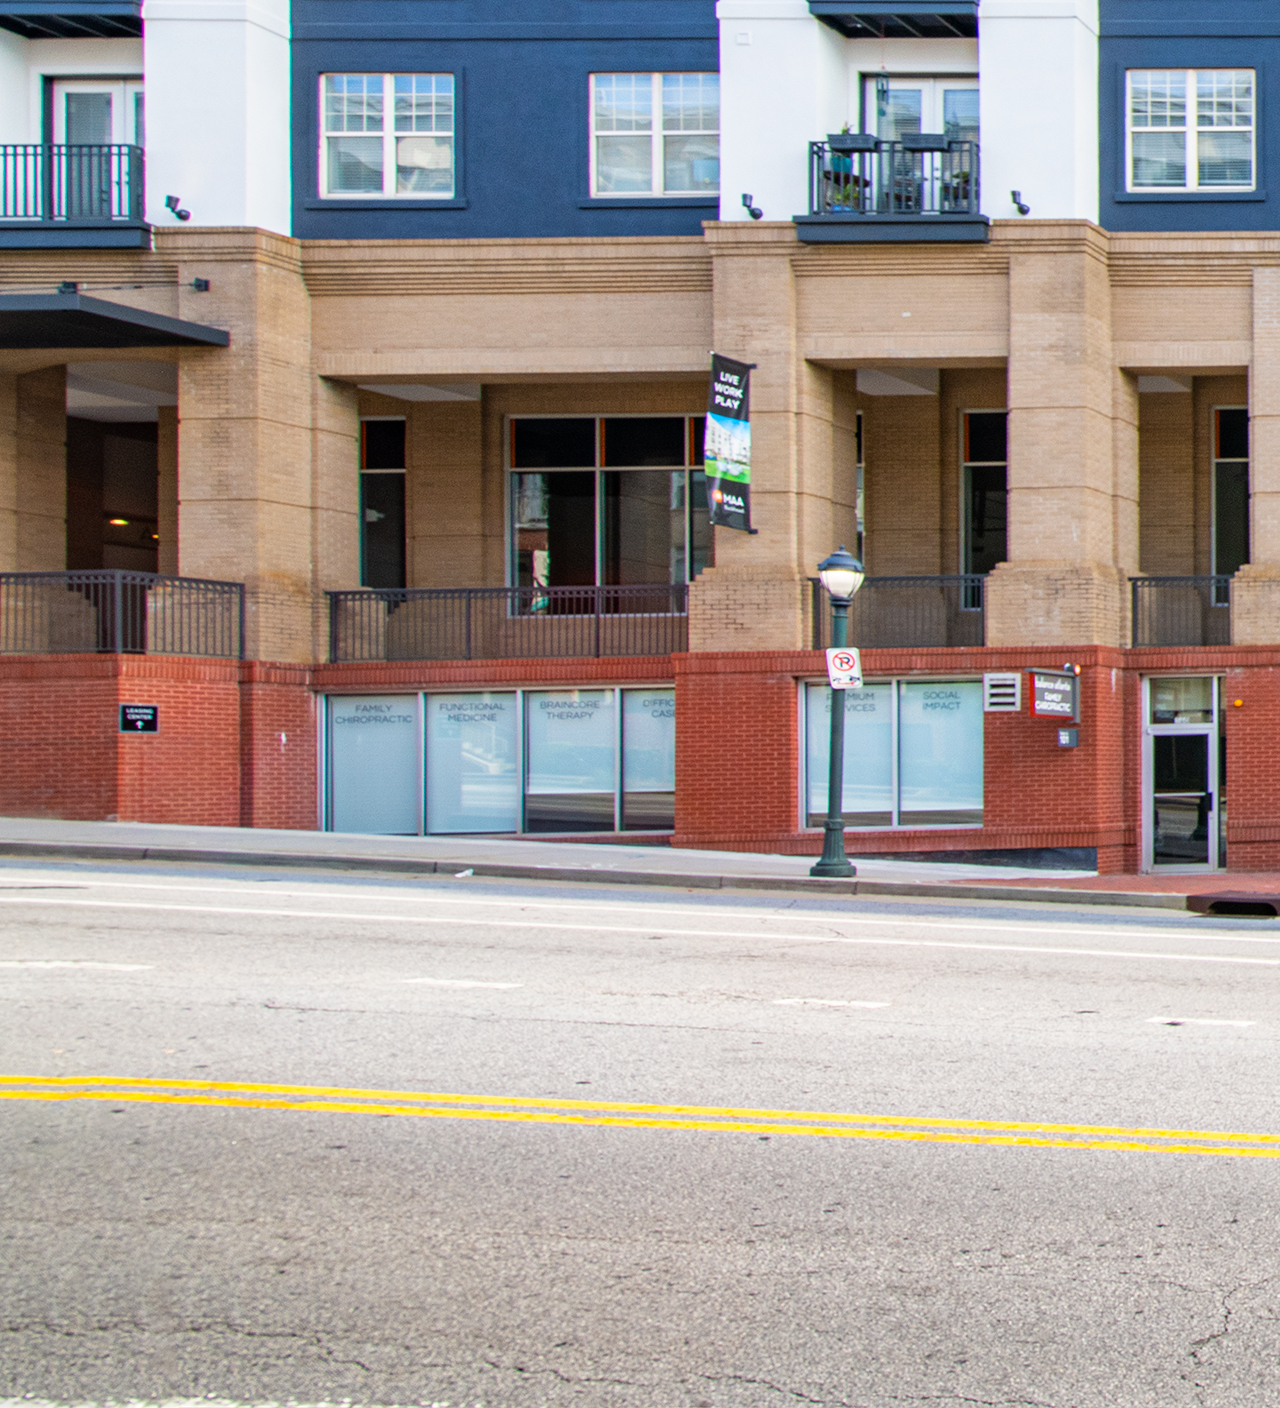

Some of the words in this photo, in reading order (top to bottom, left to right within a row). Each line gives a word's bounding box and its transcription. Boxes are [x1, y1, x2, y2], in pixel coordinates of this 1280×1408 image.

[719, 371, 740, 386] LIVE
[713, 382, 743, 399] WORK
[714, 395, 740, 409] PLAY
[723, 493, 745, 507] MAA
[826, 692, 875, 701] PMIUM
[922, 691, 961, 700] SOCIAL
[355, 704, 393, 713] FAMILY
[439, 702, 505, 712] FUNCTIONAL
[540, 700, 600, 709] BRAINCORE
[825, 703, 876, 713] SVICES
[922, 702, 961, 710] IMPACT
[335, 715, 412, 724] CHIROPRACTIC
[447, 713, 498, 722] MEDICINE
[546, 711, 594, 720] THERAPY
